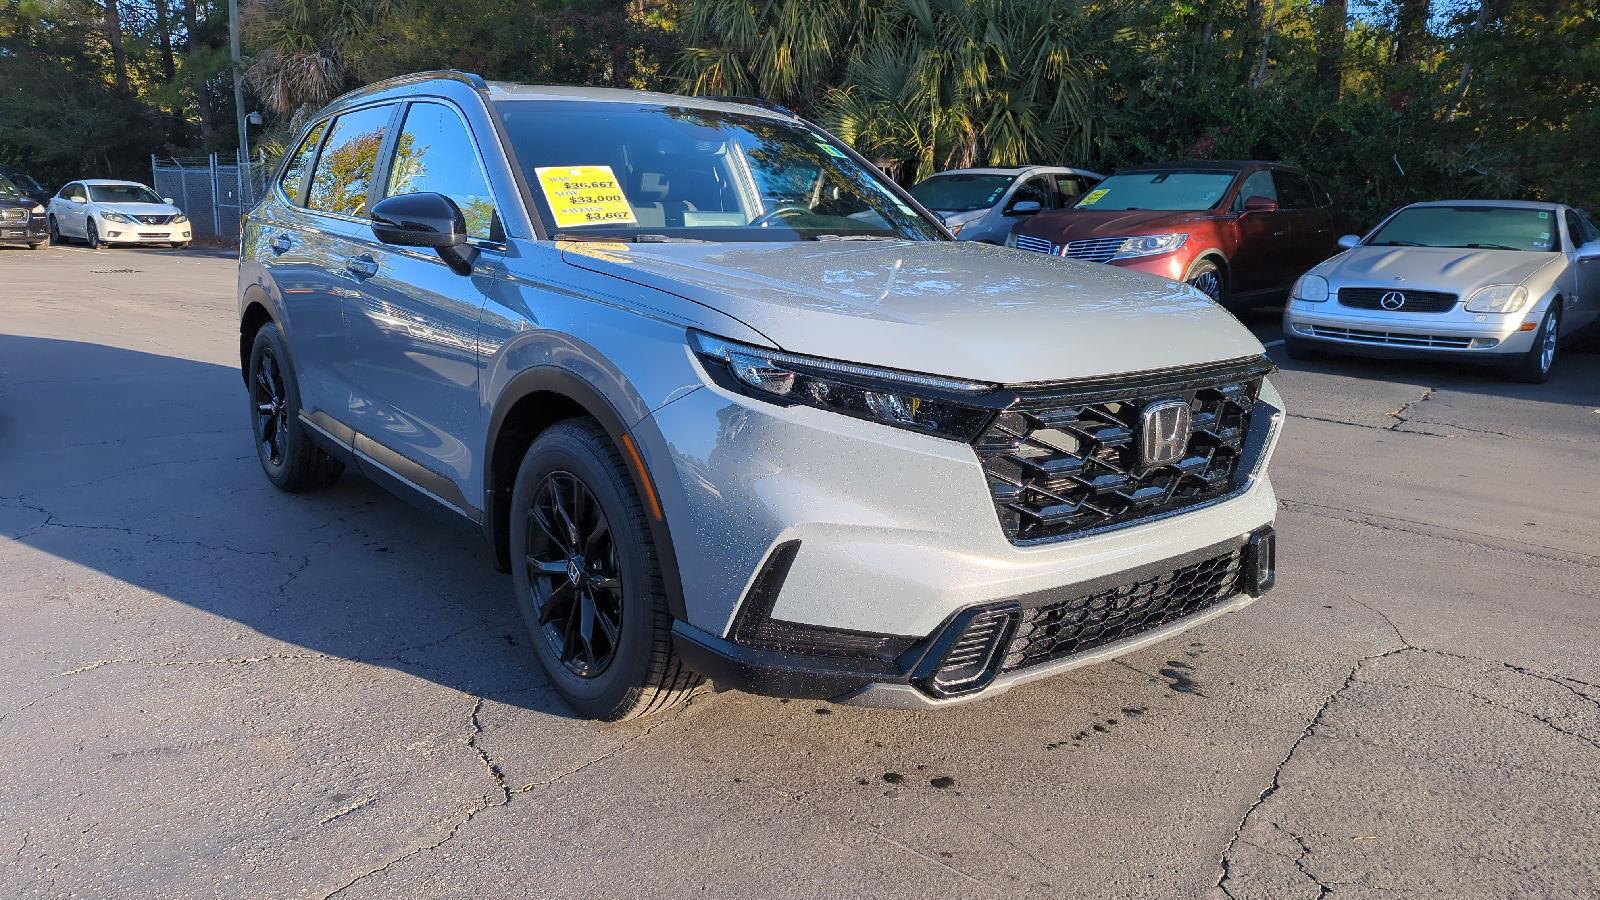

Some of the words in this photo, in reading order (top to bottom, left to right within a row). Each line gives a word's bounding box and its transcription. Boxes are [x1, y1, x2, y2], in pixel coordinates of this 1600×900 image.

[563, 181, 614, 189] $36,667
[569, 195, 621, 204] $33,000
[585, 211, 629, 220] $3,667
